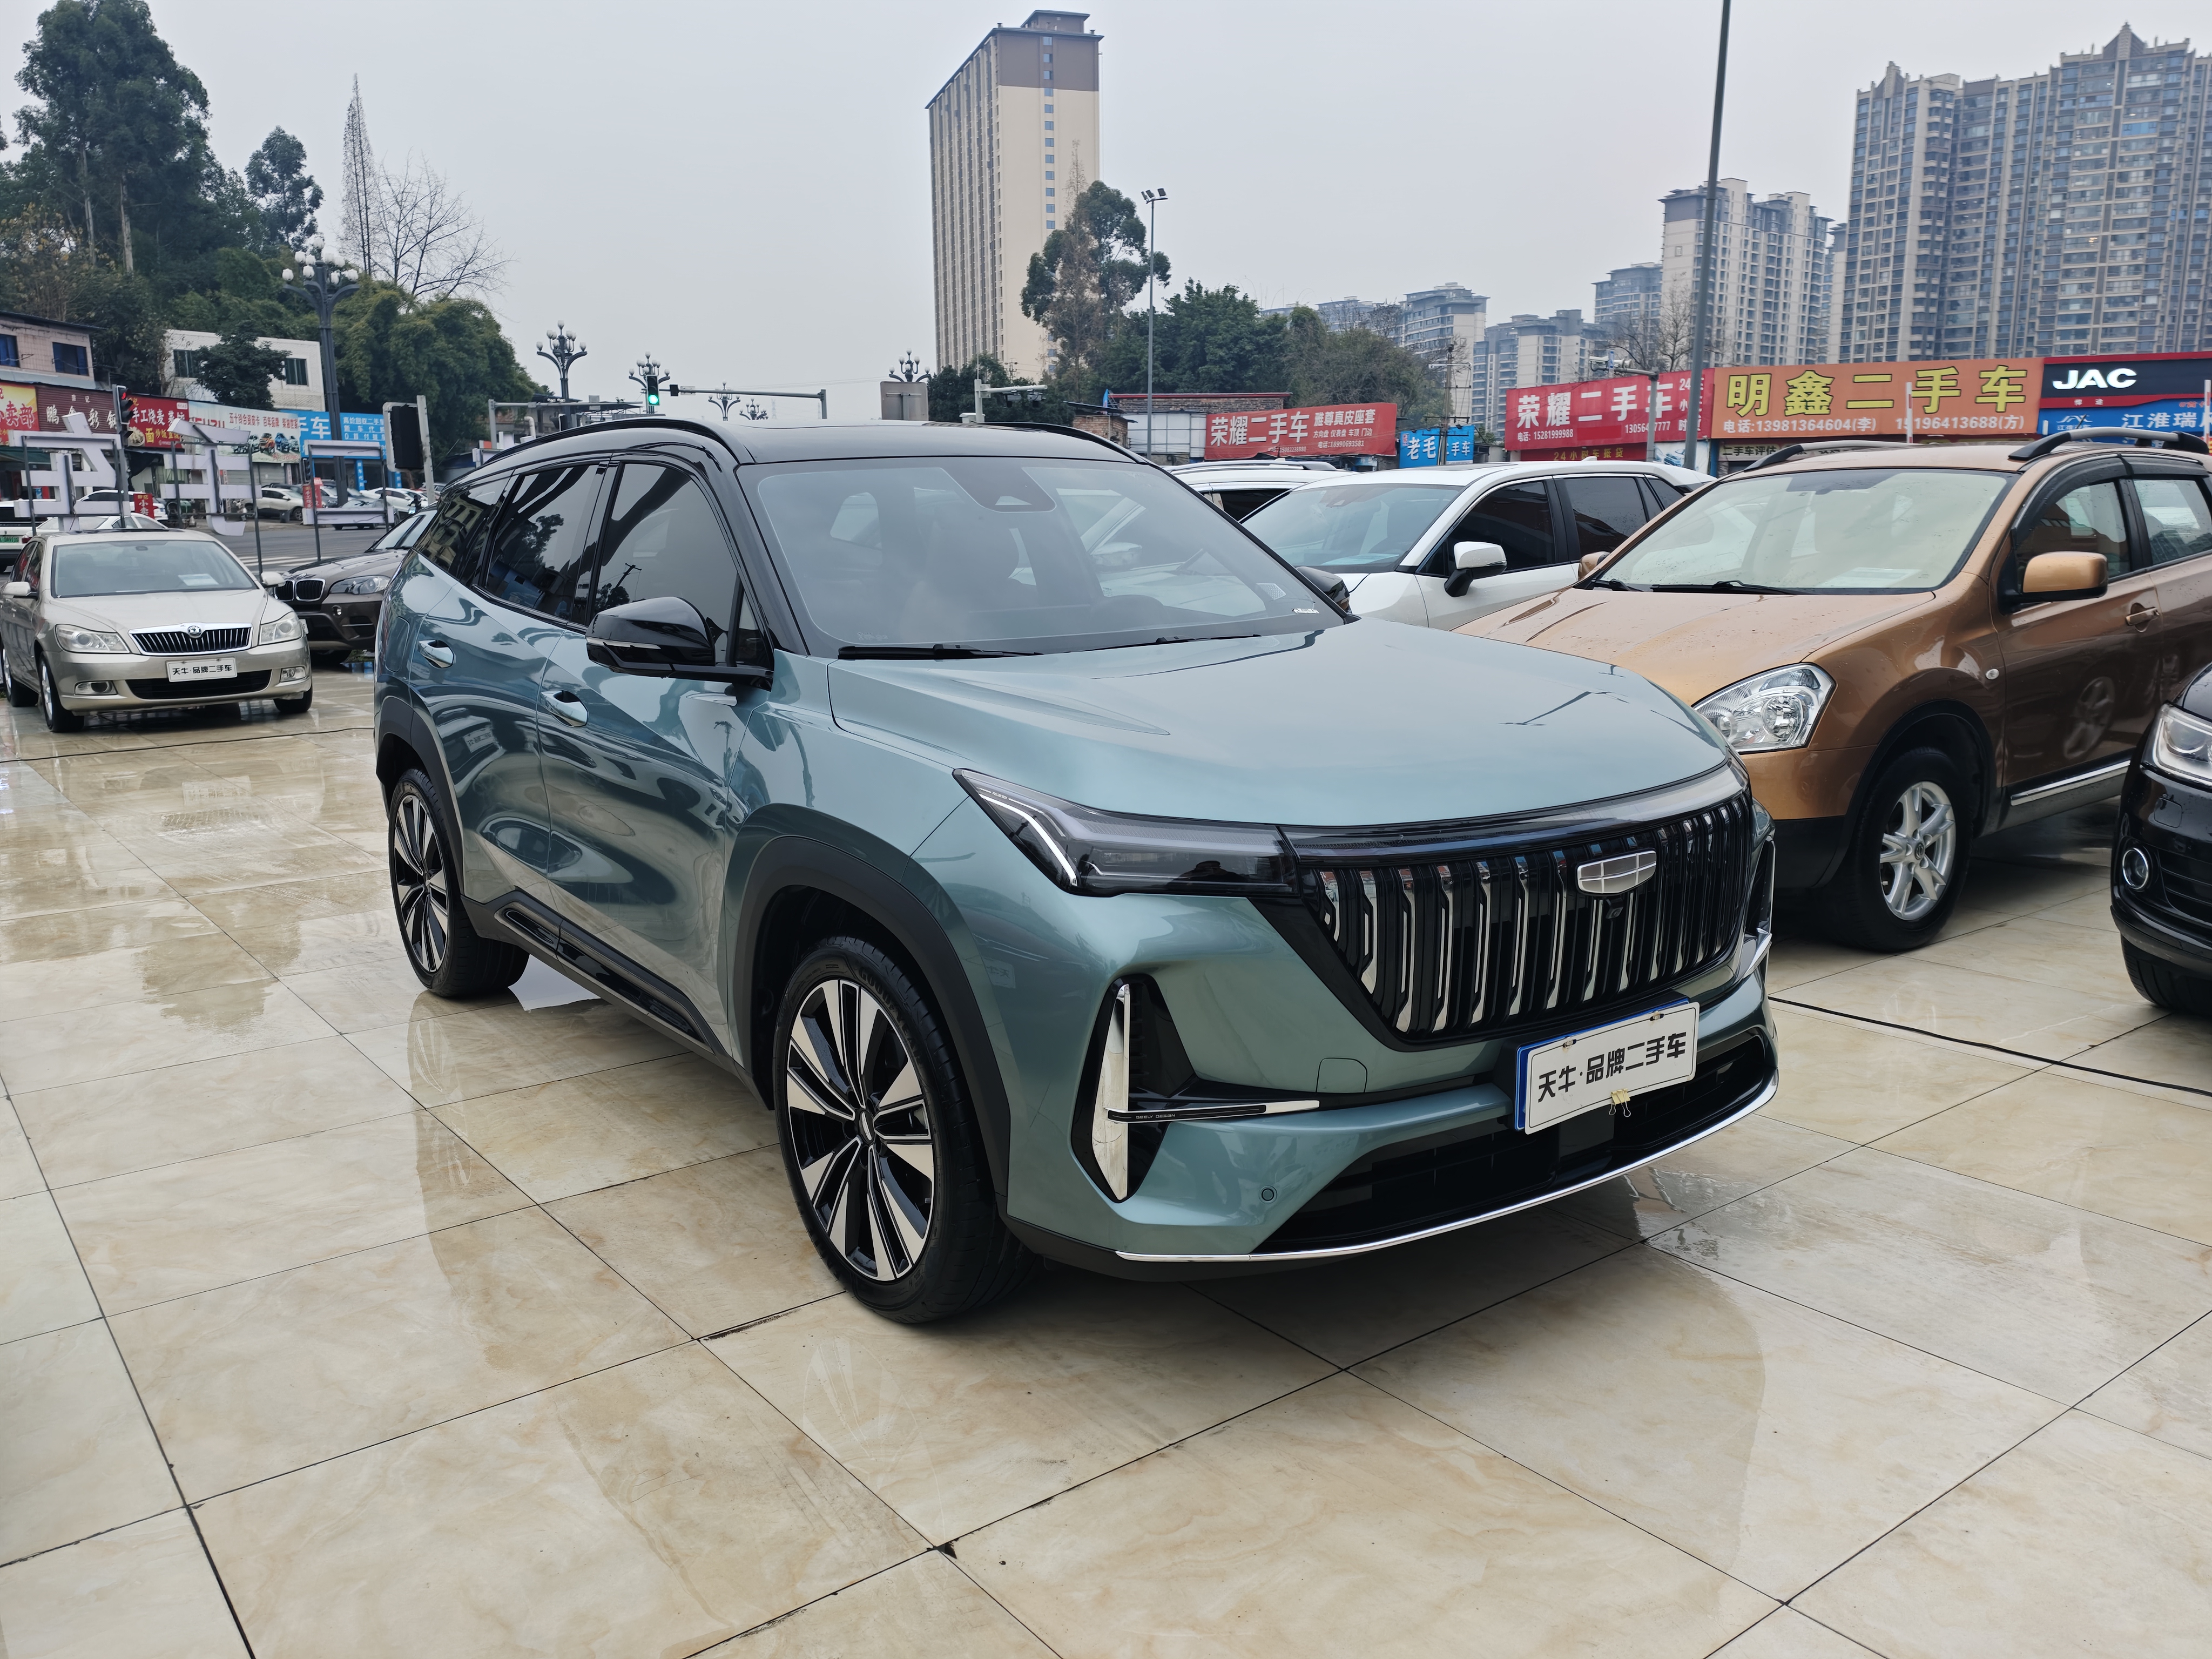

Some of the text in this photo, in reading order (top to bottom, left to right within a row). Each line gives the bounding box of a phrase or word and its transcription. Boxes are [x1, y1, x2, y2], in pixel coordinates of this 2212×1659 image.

[2052, 368, 2137, 389] JAC
[1727, 365, 2027, 417] 明鑫二手车
[1516, 381, 1674, 429] 荣耀二手车
[1314, 409, 1376, 427] 雅尊真皮座套
[1625, 421, 1671, 434] 1305647777
[145, 428, 154, 443] 面
[1210, 411, 1310, 447] 荣耀二手车
[1534, 428, 1574, 440] 15281999988
[1407, 436, 1436, 460] 老毛
[1447, 441, 1471, 456] 手车
[1722, 446, 1777, 456] 二手车评估
[1538, 1031, 1687, 1103] 天牛·品牌二手车
